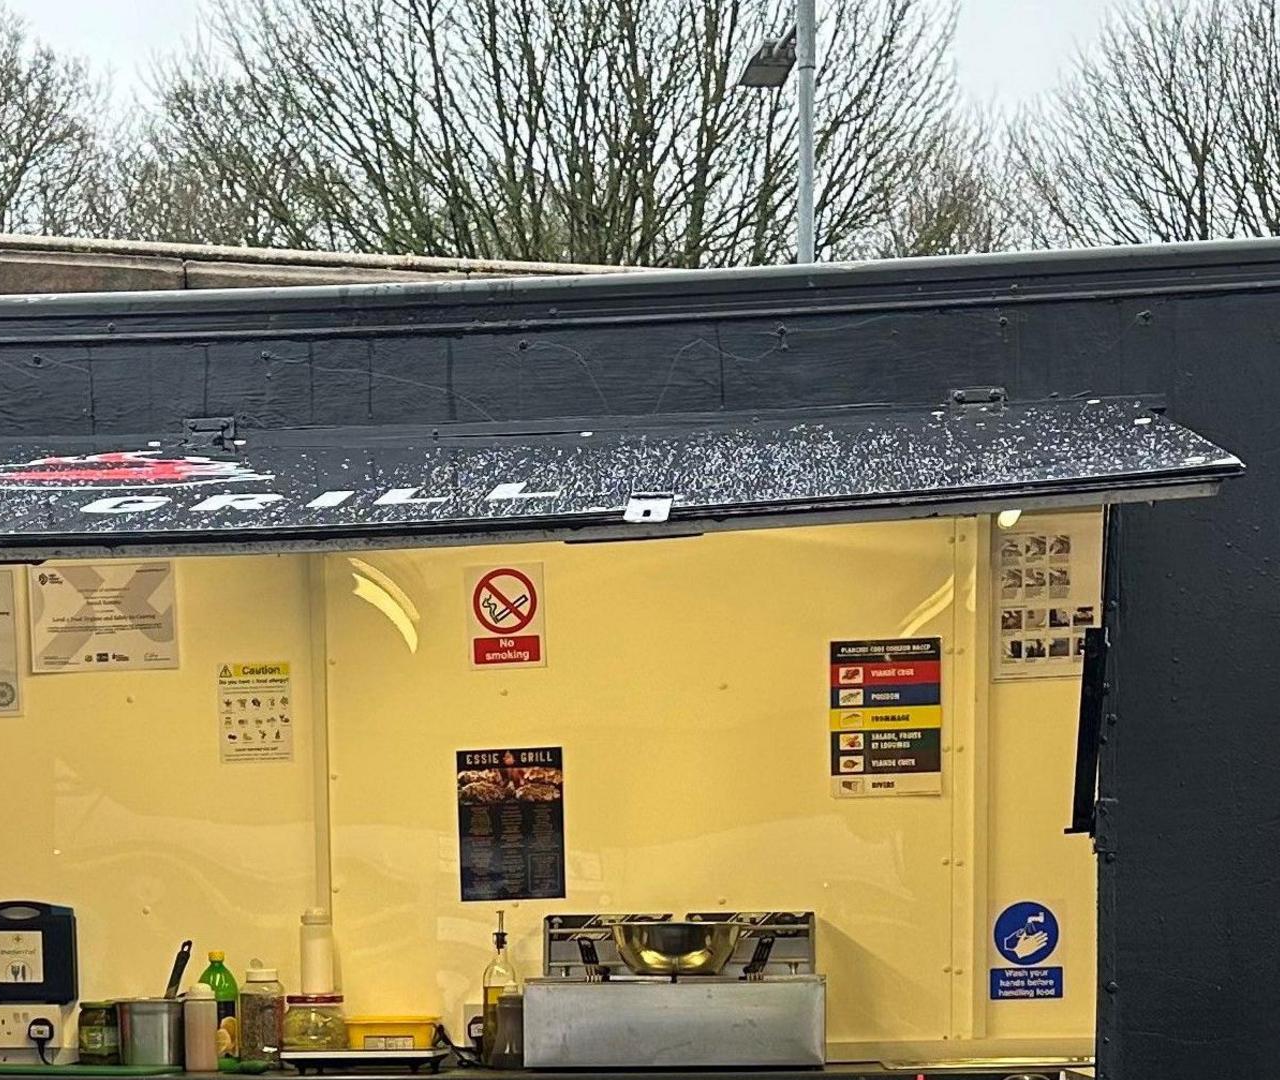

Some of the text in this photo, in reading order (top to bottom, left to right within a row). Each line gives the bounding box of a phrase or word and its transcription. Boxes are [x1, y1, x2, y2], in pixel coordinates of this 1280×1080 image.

[78, 482, 561, 514] GRILL
[500, 639, 514, 648] No
[485, 650, 530, 660] smoking
[242, 666, 280, 675] Caution
[466, 751, 552, 764] ESSIE GRILL
[1030, 970, 1048, 978] your
